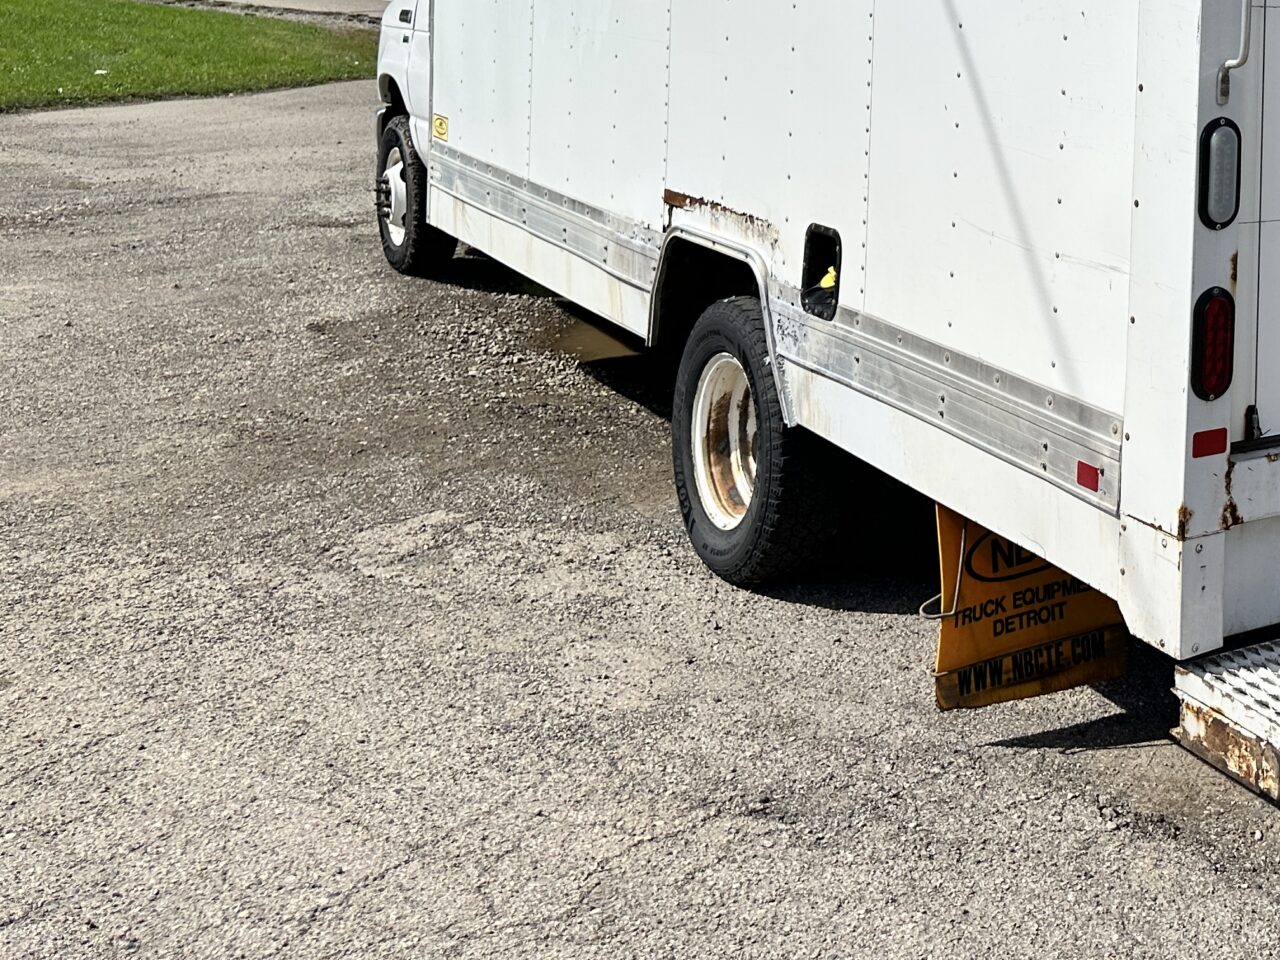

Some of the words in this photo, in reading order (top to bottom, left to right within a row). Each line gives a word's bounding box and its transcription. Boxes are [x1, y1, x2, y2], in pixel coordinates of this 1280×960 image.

[954, 595, 1006, 628] TRUCK
[992, 602, 1067, 637] DETROIT
[957, 631, 1105, 696] WWW.NBCTE.COM
